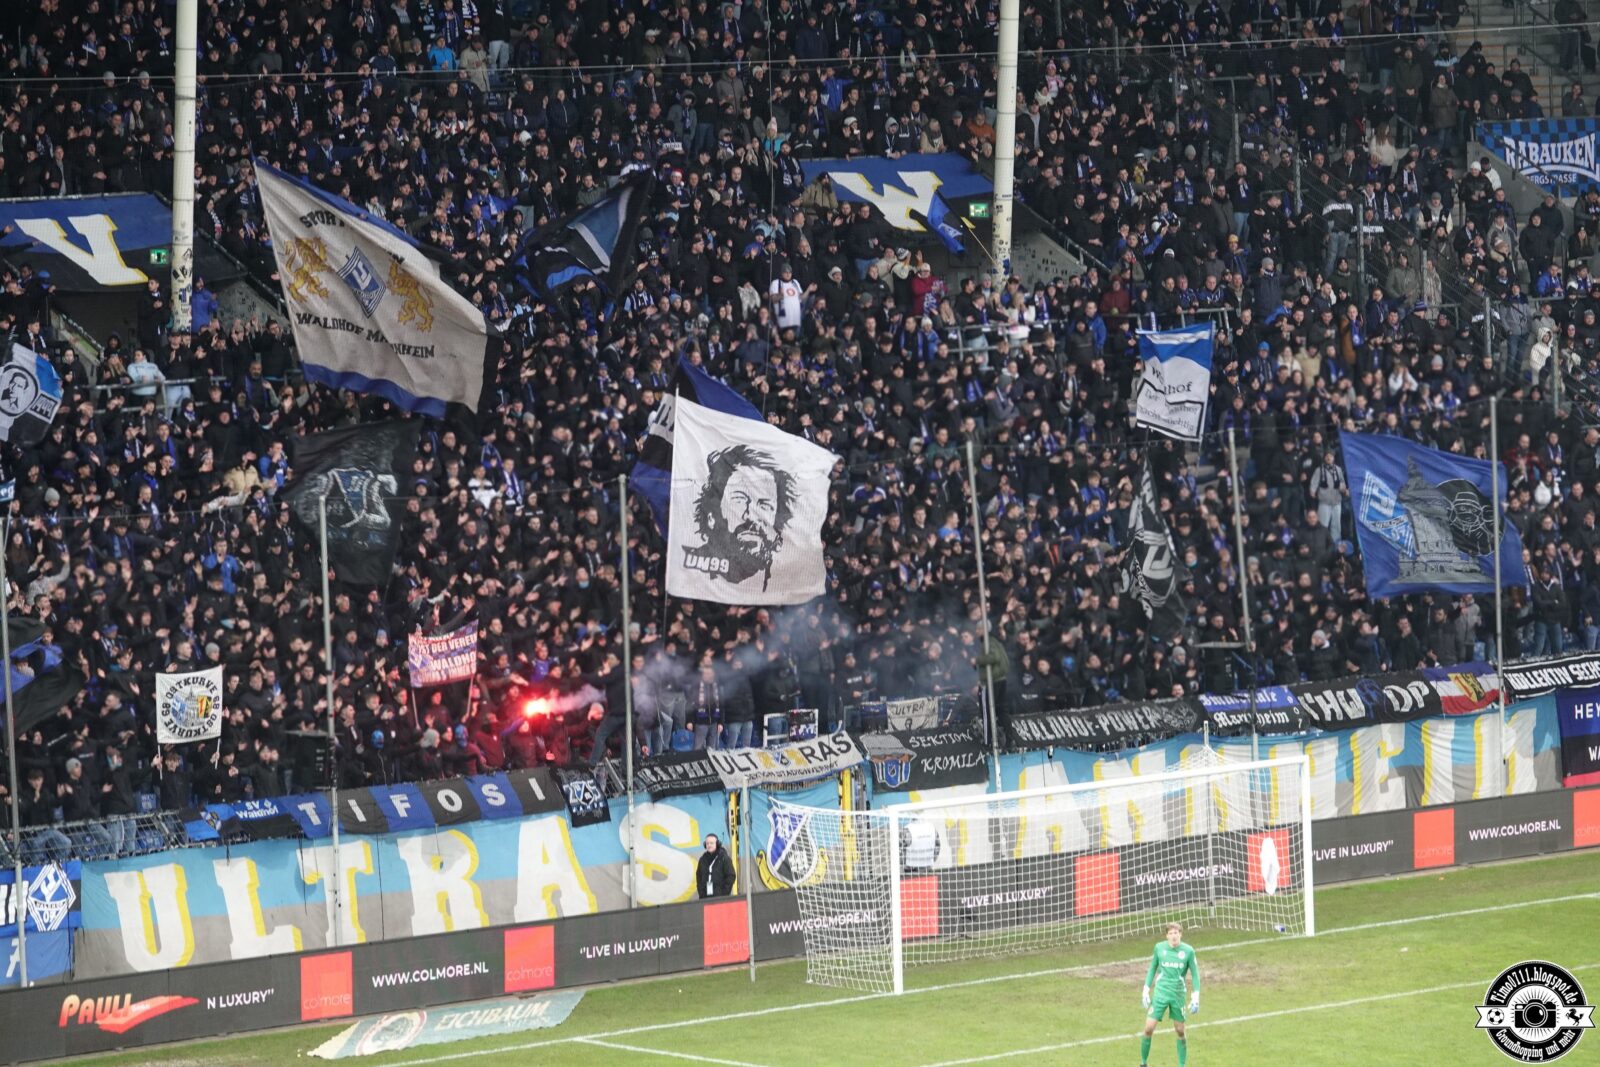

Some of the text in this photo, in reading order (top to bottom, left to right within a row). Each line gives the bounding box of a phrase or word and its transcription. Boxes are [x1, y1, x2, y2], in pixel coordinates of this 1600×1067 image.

[1503, 133, 1596, 171] RABAUKEN
[296, 312, 364, 335] WALDHOF
[685, 555, 730, 573] UM99
[1504, 667, 1573, 690] KOLLEKTIV
[909, 728, 974, 749] SEKTION
[245, 800, 260, 810] SV
[1469, 819, 1562, 842] WWW.COLMORE.NL
[1338, 845, 1350, 857] IN
[613, 942, 626, 955] IN
[372, 961, 490, 988] WWW.COLMORE.NL
